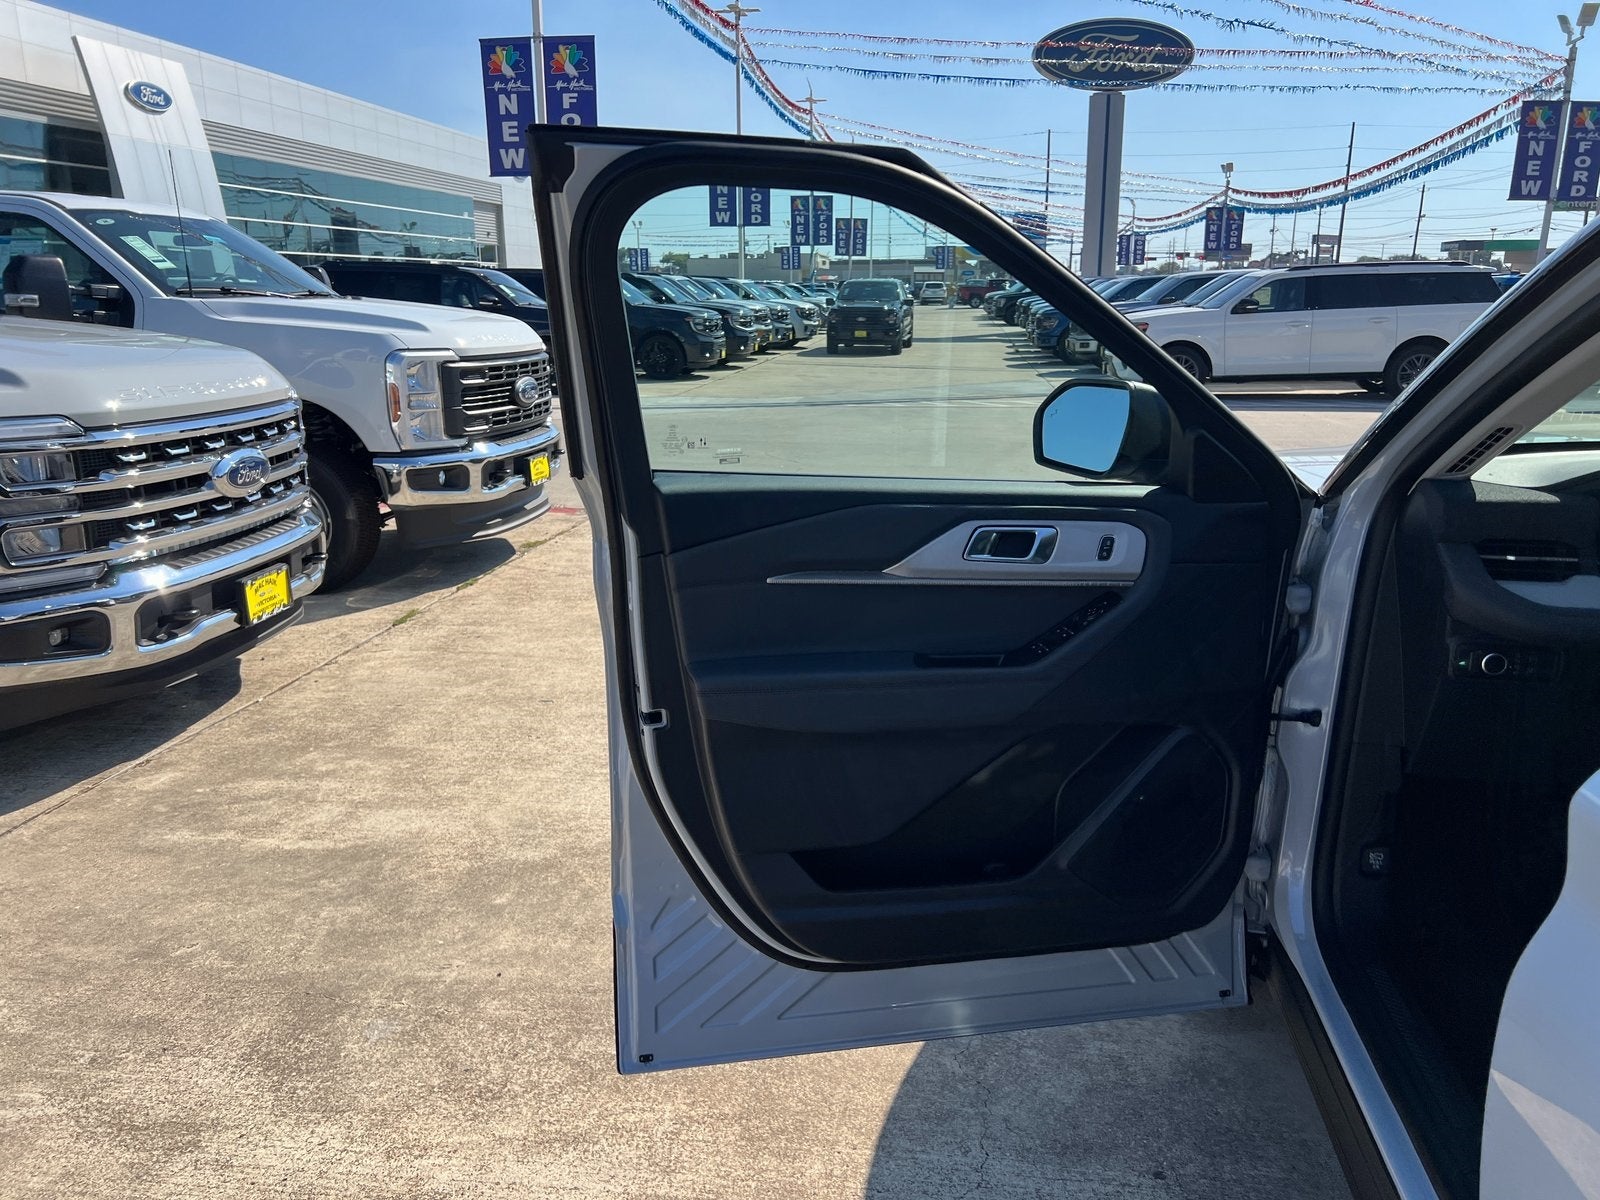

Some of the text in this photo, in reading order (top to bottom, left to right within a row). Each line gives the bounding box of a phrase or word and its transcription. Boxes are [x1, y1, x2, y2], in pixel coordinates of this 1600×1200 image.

[1069, 33, 1159, 73] Ford
[140, 86, 165, 105] Ford
[498, 93, 525, 169] NEW
[1521, 140, 1545, 196] NEW
[1570, 142, 1593, 197] FORD
[715, 185, 731, 223] NEW
[750, 186, 762, 224] ORD
[795, 215, 806, 243] NEW
[819, 215, 828, 244] FORD
[839, 233, 847, 254] NEW
[1207, 224, 1217, 249] NEW
[1229, 223, 1238, 249] FORD
[238, 461, 262, 485] Ford
